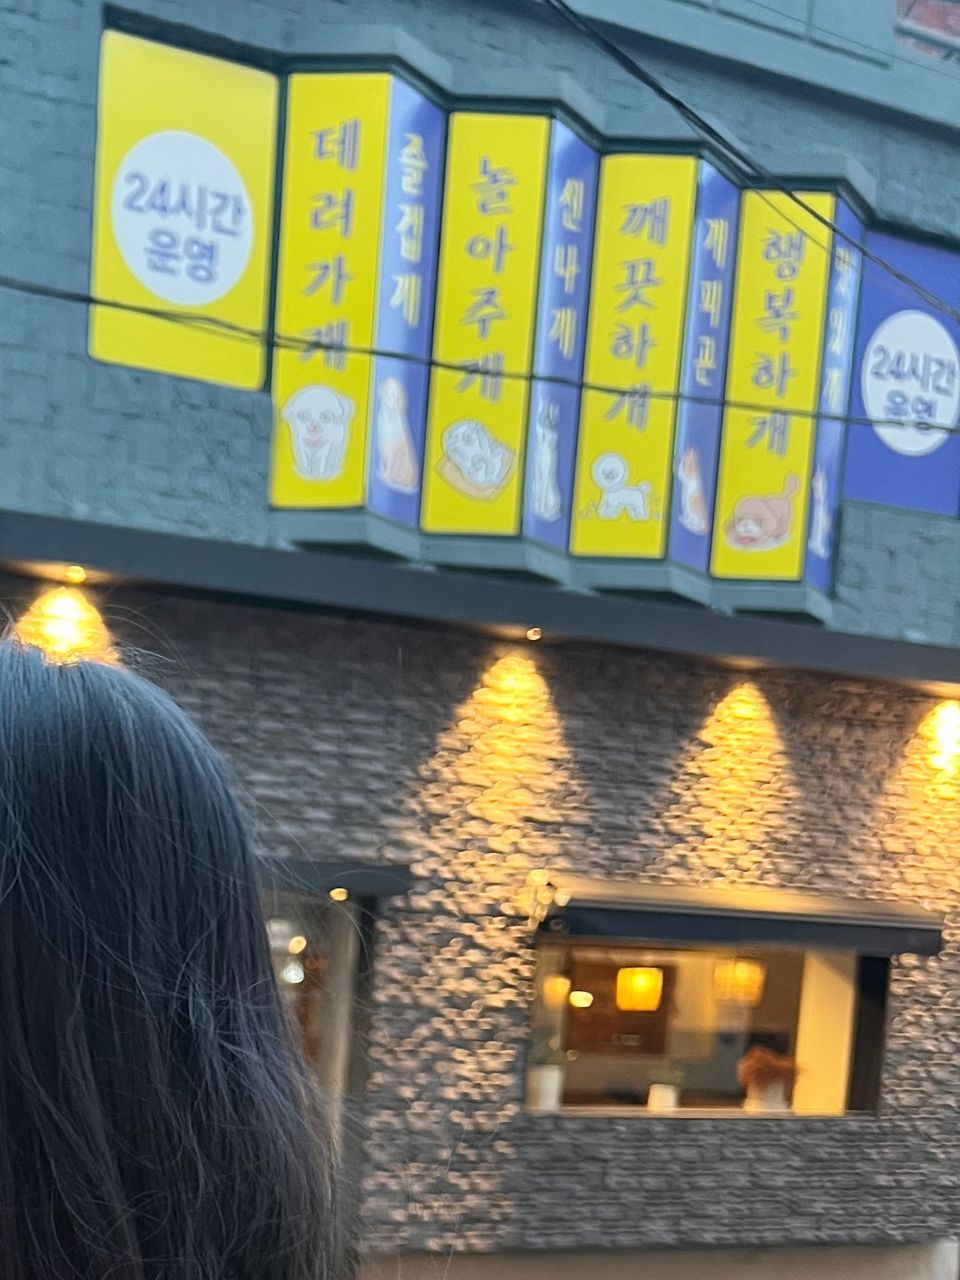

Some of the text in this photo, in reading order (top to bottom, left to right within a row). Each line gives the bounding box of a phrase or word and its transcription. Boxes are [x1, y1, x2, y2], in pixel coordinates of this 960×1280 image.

[123, 171, 244, 236] 24시간
[144, 229, 218, 283] 운영
[870, 344, 957, 397] 24시간
[882, 389, 937, 434] 운영
